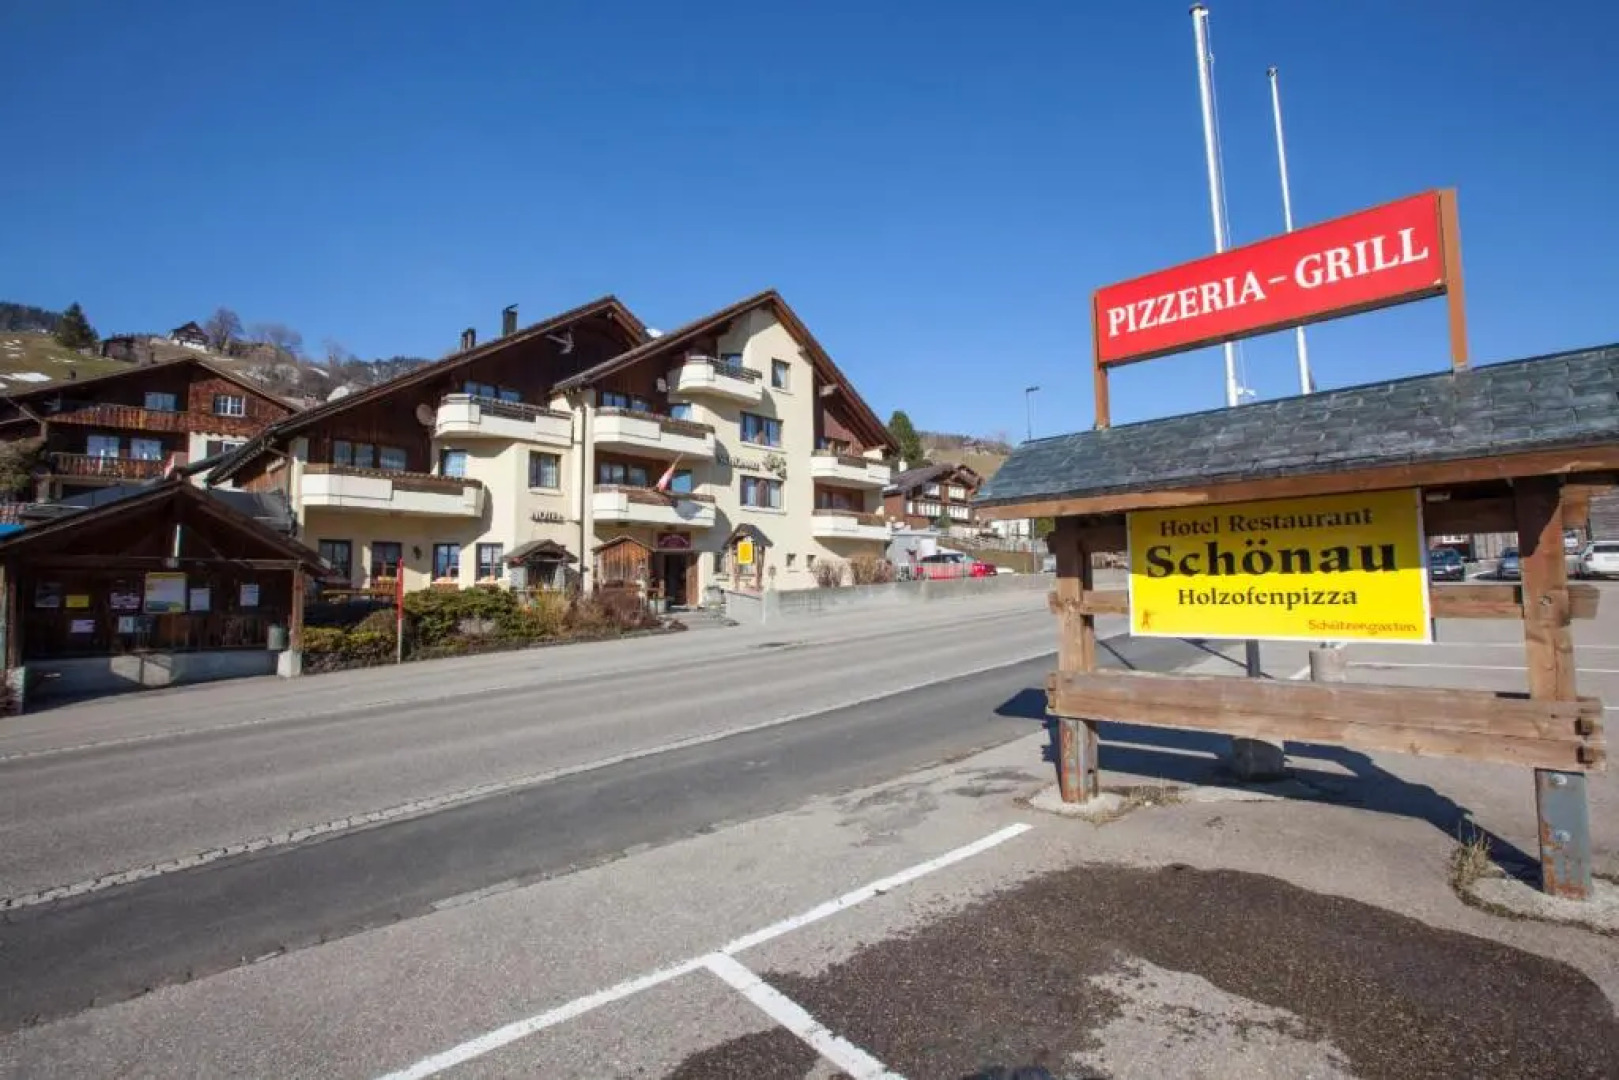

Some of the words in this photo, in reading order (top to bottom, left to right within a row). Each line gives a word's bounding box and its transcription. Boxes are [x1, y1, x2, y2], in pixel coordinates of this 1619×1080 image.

[1107, 271, 1266, 336] PIZZERIA
[1294, 227, 1429, 289] GRILL
[1160, 516, 1219, 537] Hotel
[1230, 509, 1373, 533] Restaurant
[1146, 539, 1398, 578] Schönau
[1178, 587, 1358, 611] Holzofenpizza
